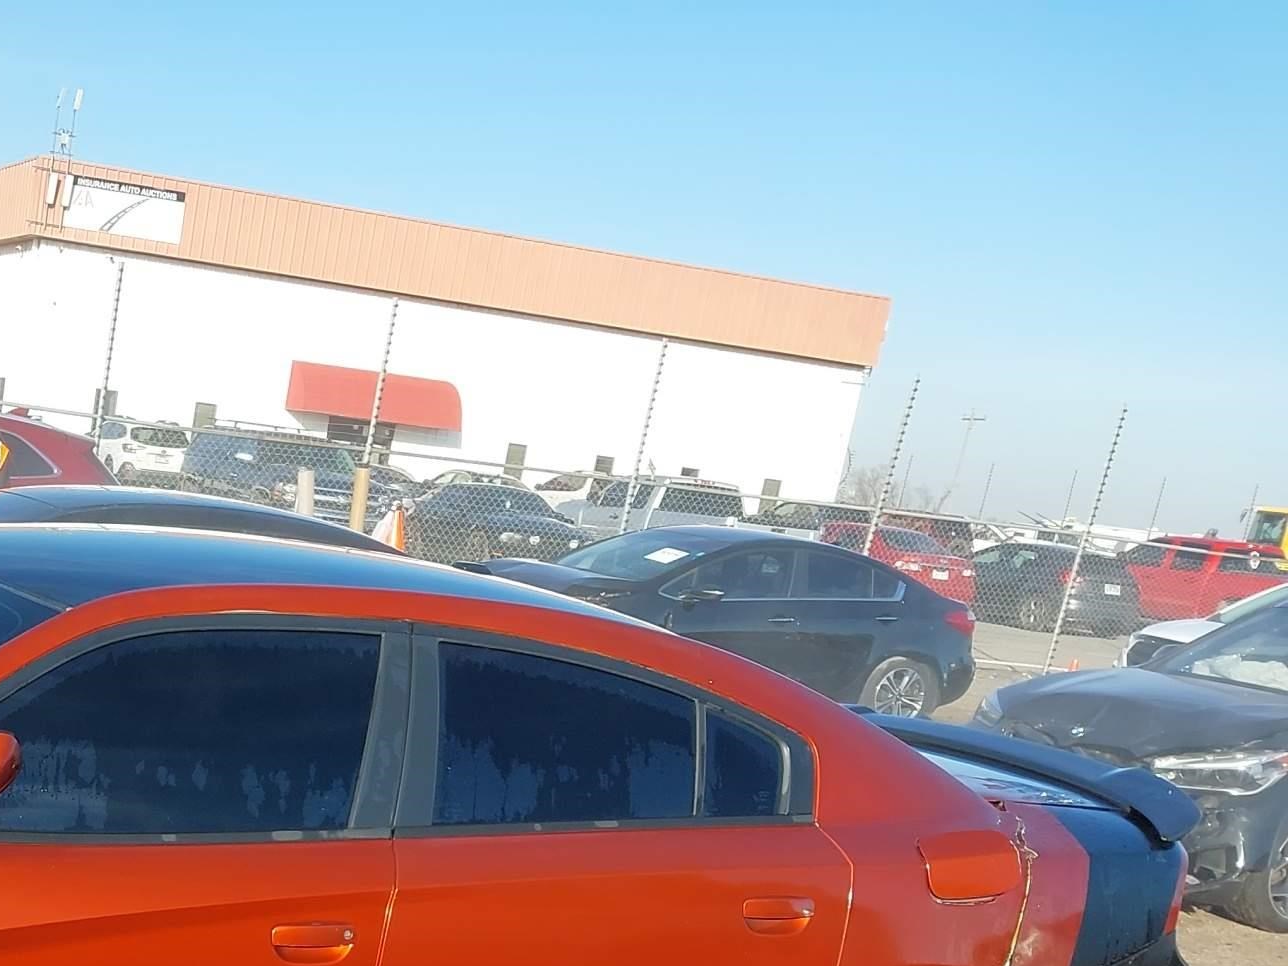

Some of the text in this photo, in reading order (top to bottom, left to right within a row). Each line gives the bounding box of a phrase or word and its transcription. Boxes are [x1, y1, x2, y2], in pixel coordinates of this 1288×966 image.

[77, 177, 178, 201] INSURANCE AUTO AUCTIONS
